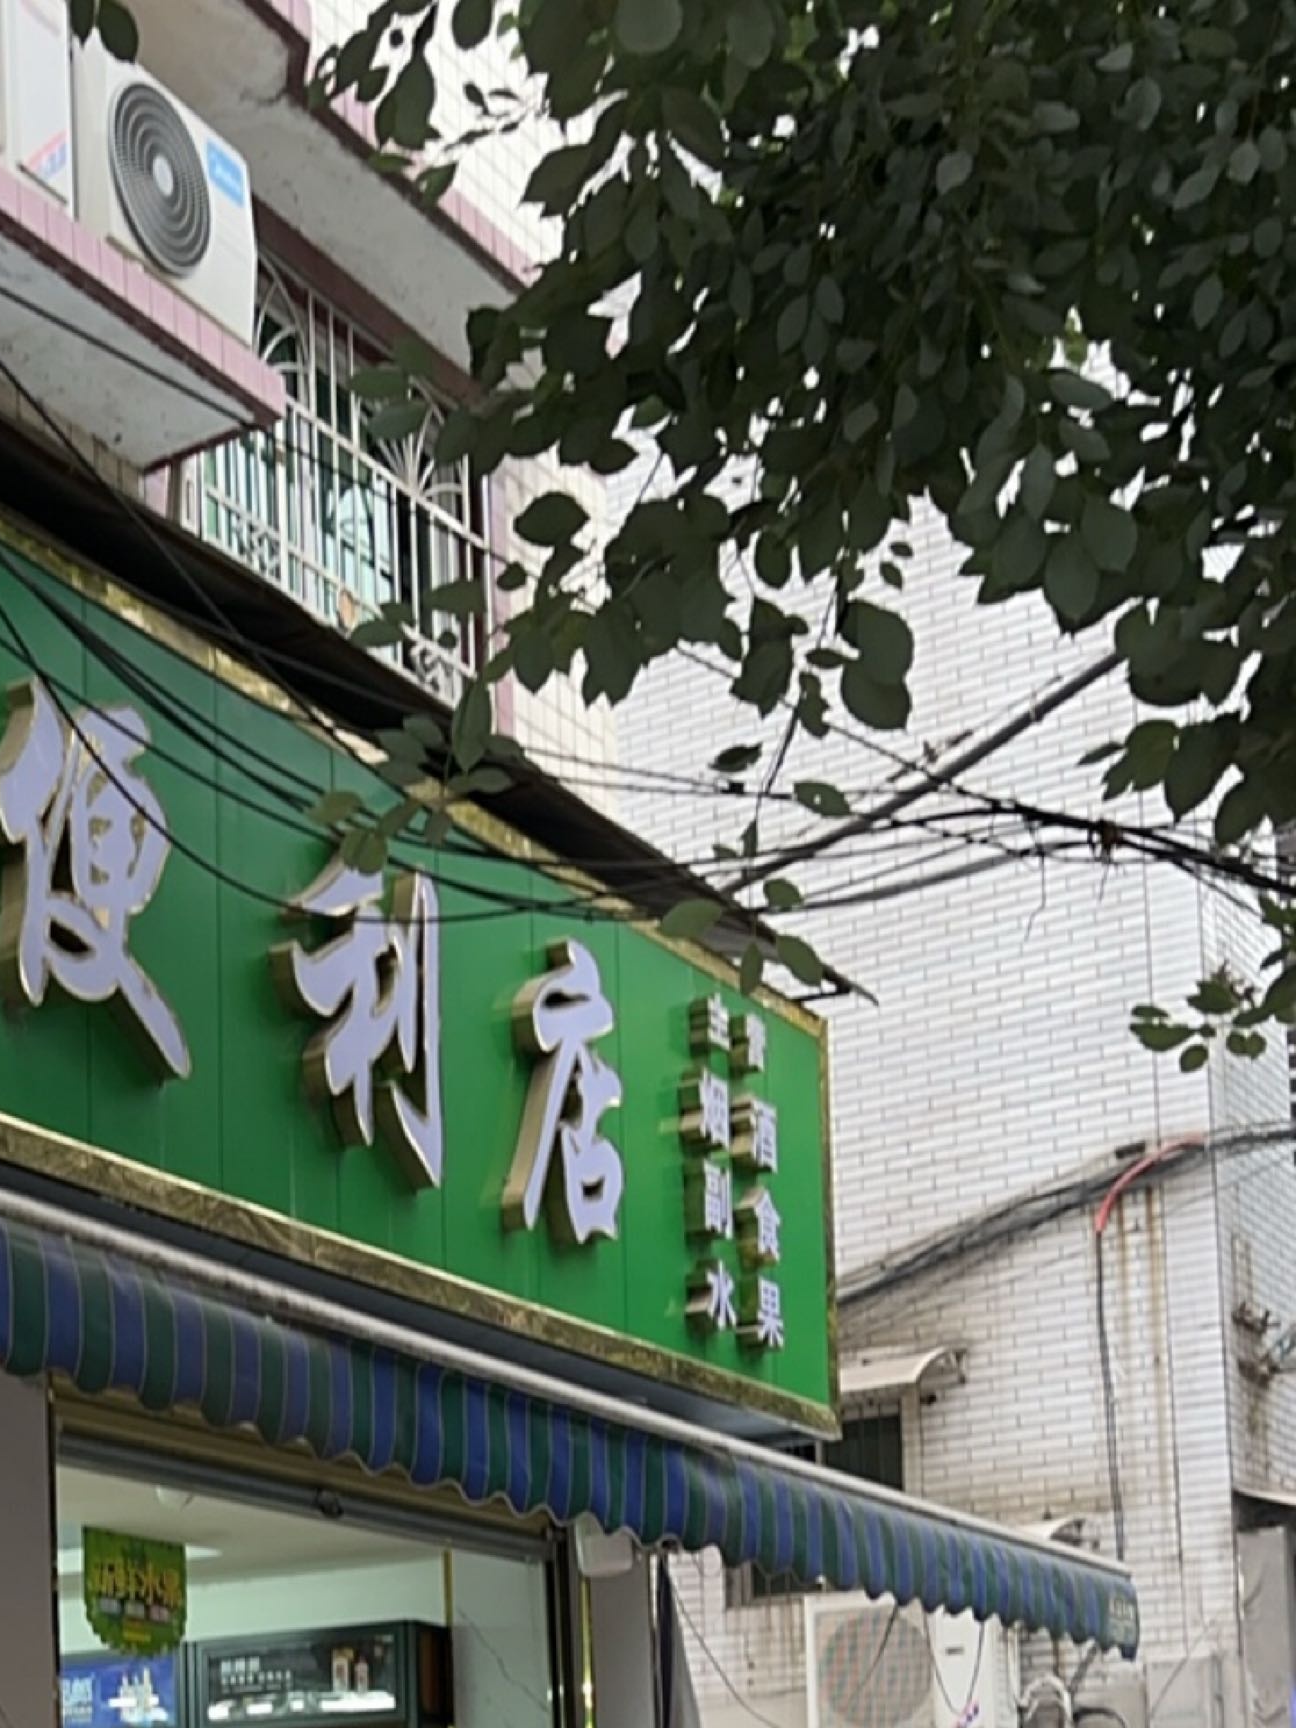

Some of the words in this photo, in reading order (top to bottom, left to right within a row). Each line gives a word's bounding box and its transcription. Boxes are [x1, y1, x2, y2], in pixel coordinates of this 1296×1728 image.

[692, 1067, 778, 1174] 烟酒
[697, 1158, 781, 1263] 副食
[700, 1260, 784, 1348] 水果
